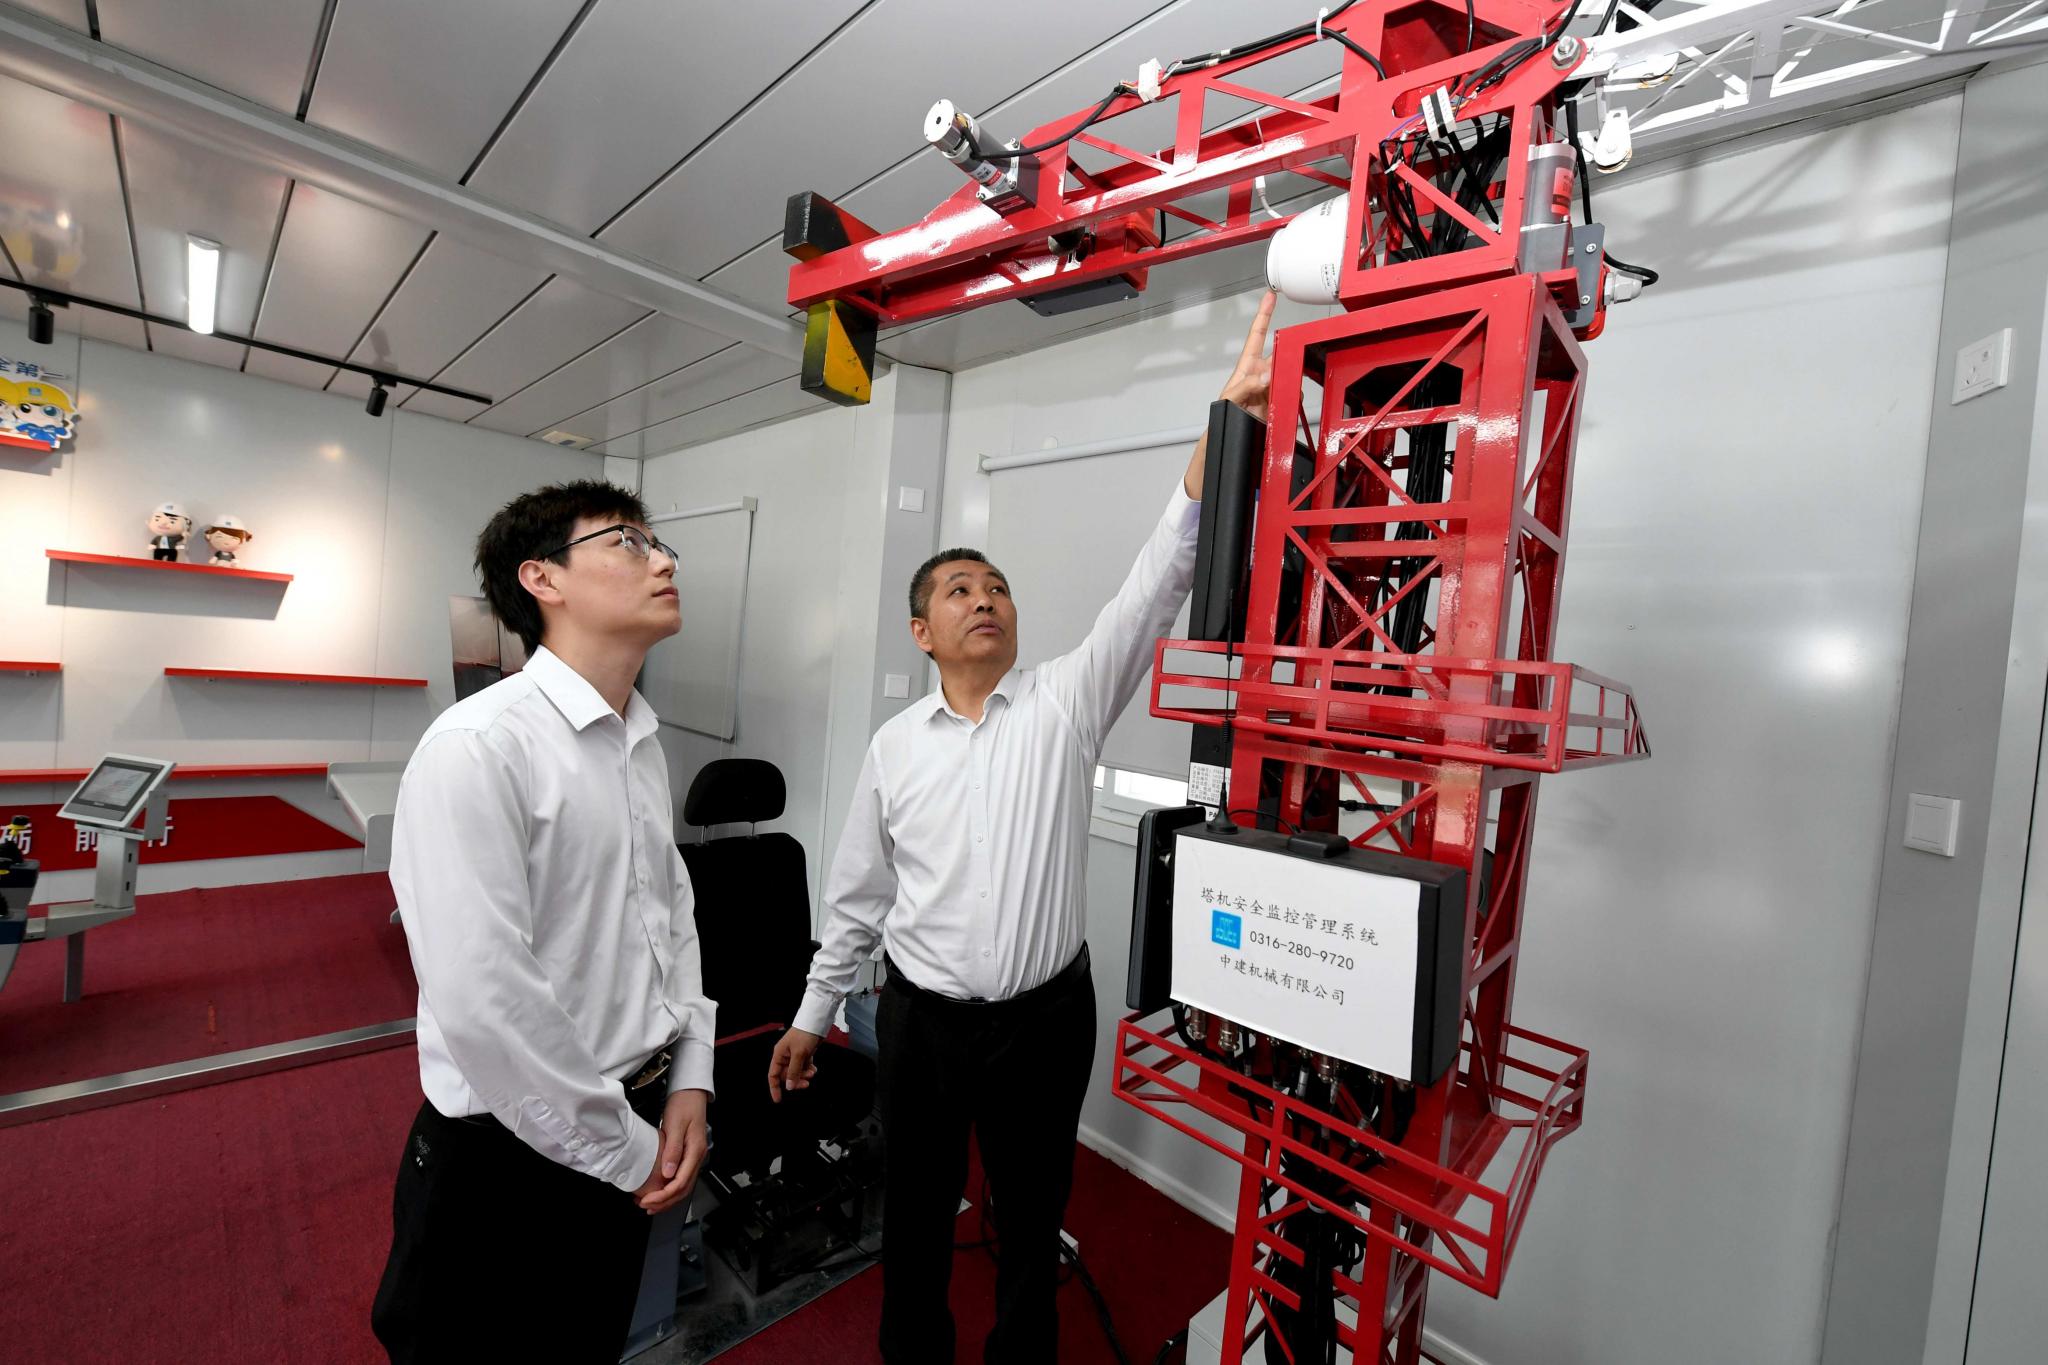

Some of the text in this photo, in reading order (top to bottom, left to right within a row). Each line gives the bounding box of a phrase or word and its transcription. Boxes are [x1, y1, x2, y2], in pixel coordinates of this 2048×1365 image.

[1200, 886, 1379, 946] 塔机安全监控管理系统
[1249, 931, 1354, 970] 0316-280-9720
[1220, 954, 1345, 1006] 中建机械有限公司
